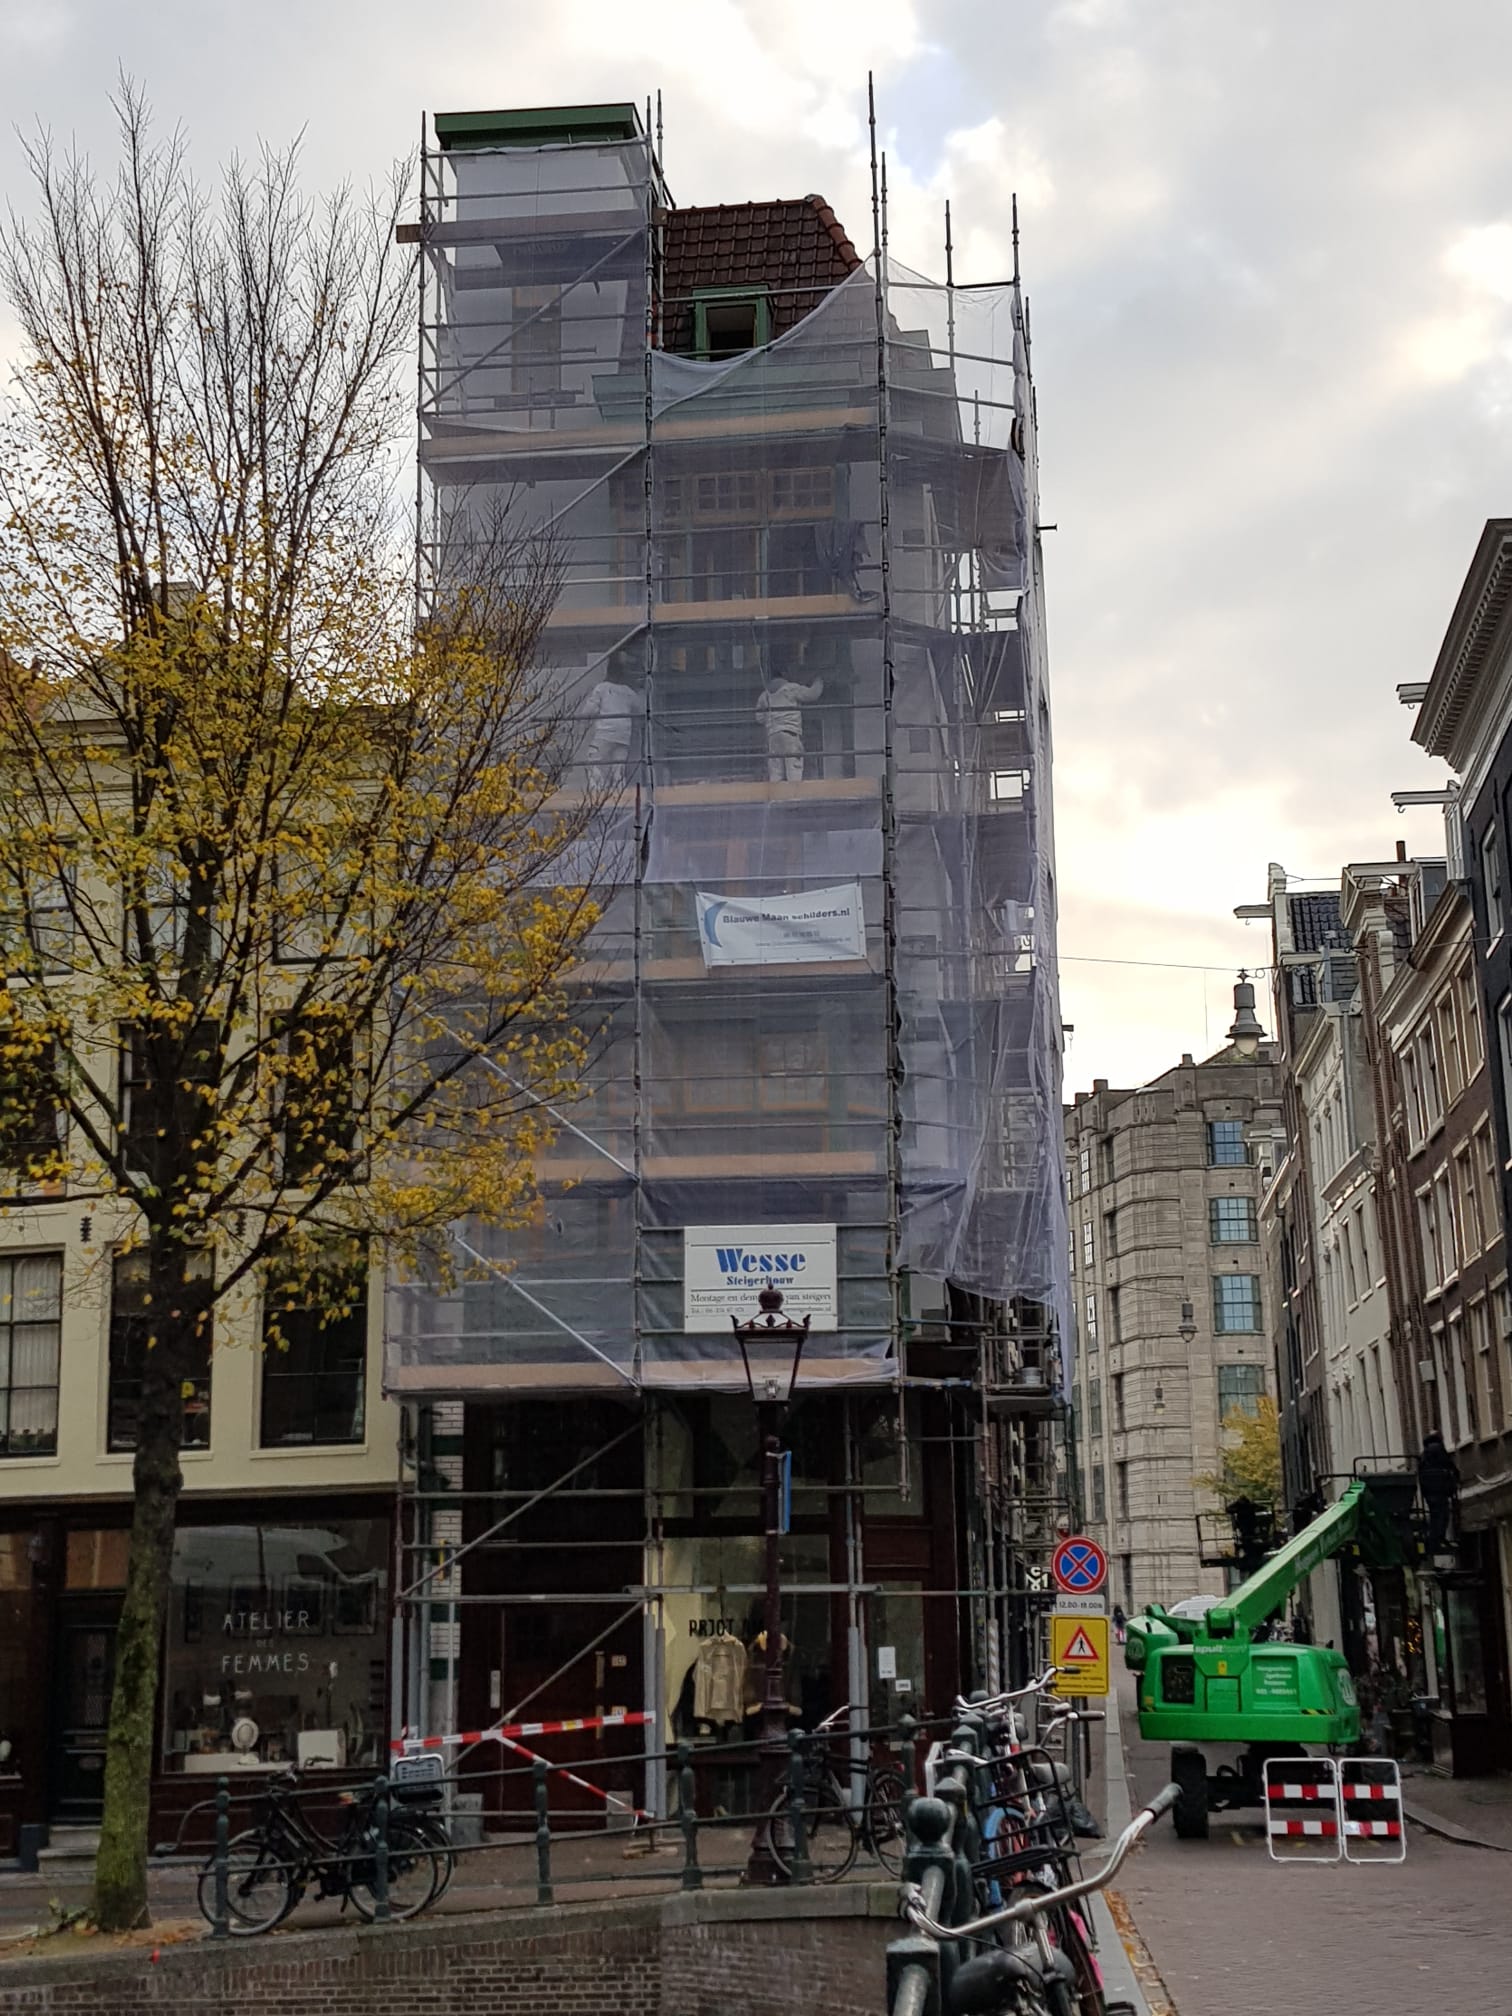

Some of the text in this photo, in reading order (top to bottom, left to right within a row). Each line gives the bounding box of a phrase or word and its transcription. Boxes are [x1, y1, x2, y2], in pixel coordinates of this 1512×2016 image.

[761, 912, 789, 921] Maan
[716, 1248, 806, 1273] Wesse
[690, 1293, 725, 1303] Montage
[802, 1292, 831, 1302] steigers
[223, 1610, 310, 1631] ATELIER
[222, 1653, 309, 1673] FEMMES
